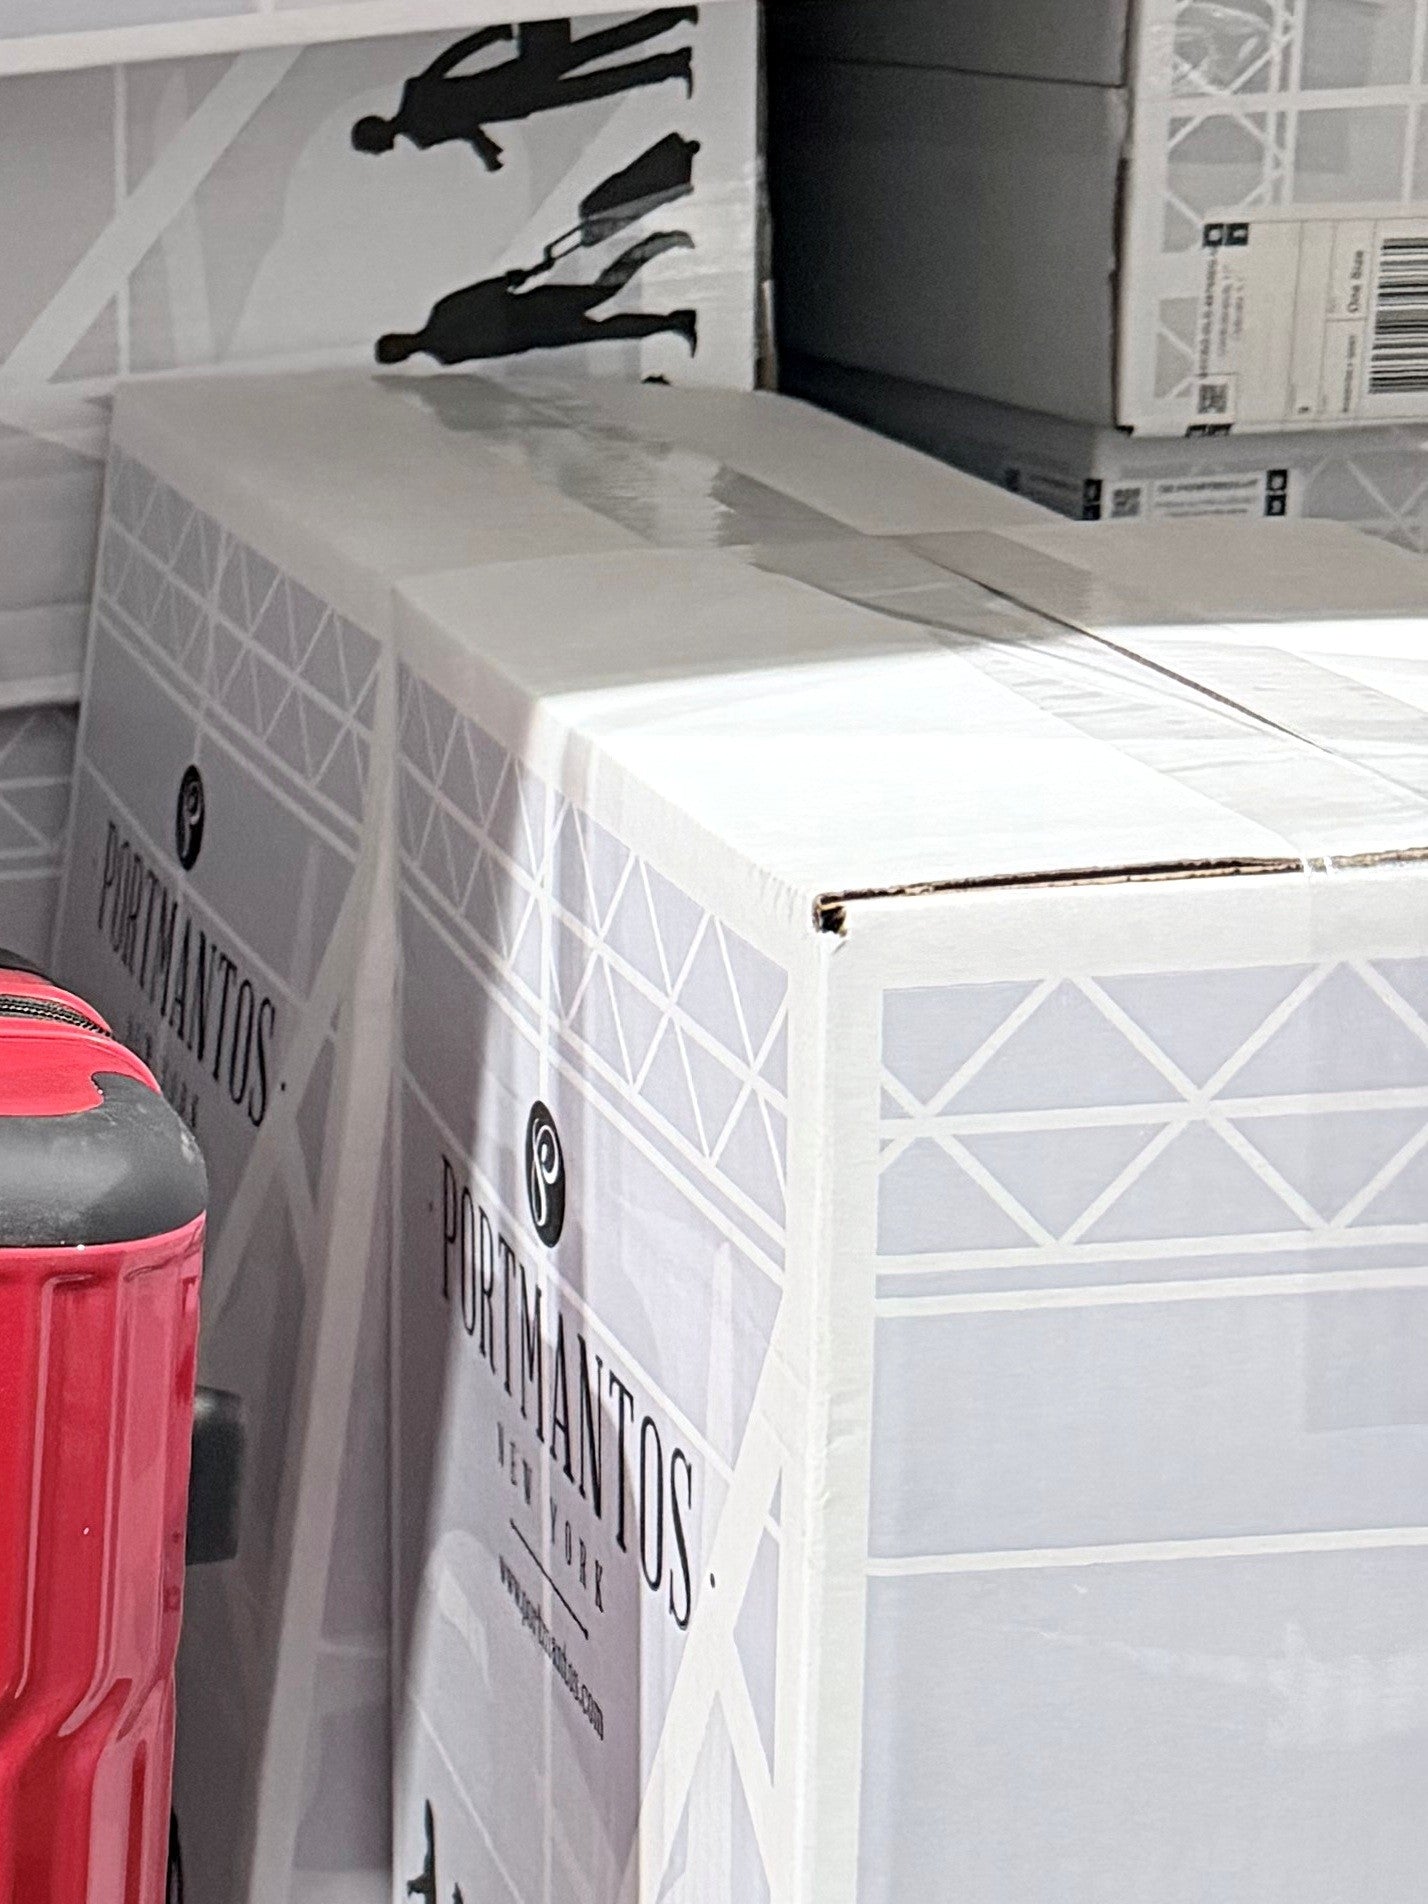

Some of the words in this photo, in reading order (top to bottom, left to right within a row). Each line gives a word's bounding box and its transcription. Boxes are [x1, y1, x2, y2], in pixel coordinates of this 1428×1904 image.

[98, 819, 276, 1128] PORTMANTOS
[442, 1153, 693, 1632] PORTMANTOS
[549, 1496, 604, 1614] YORK
